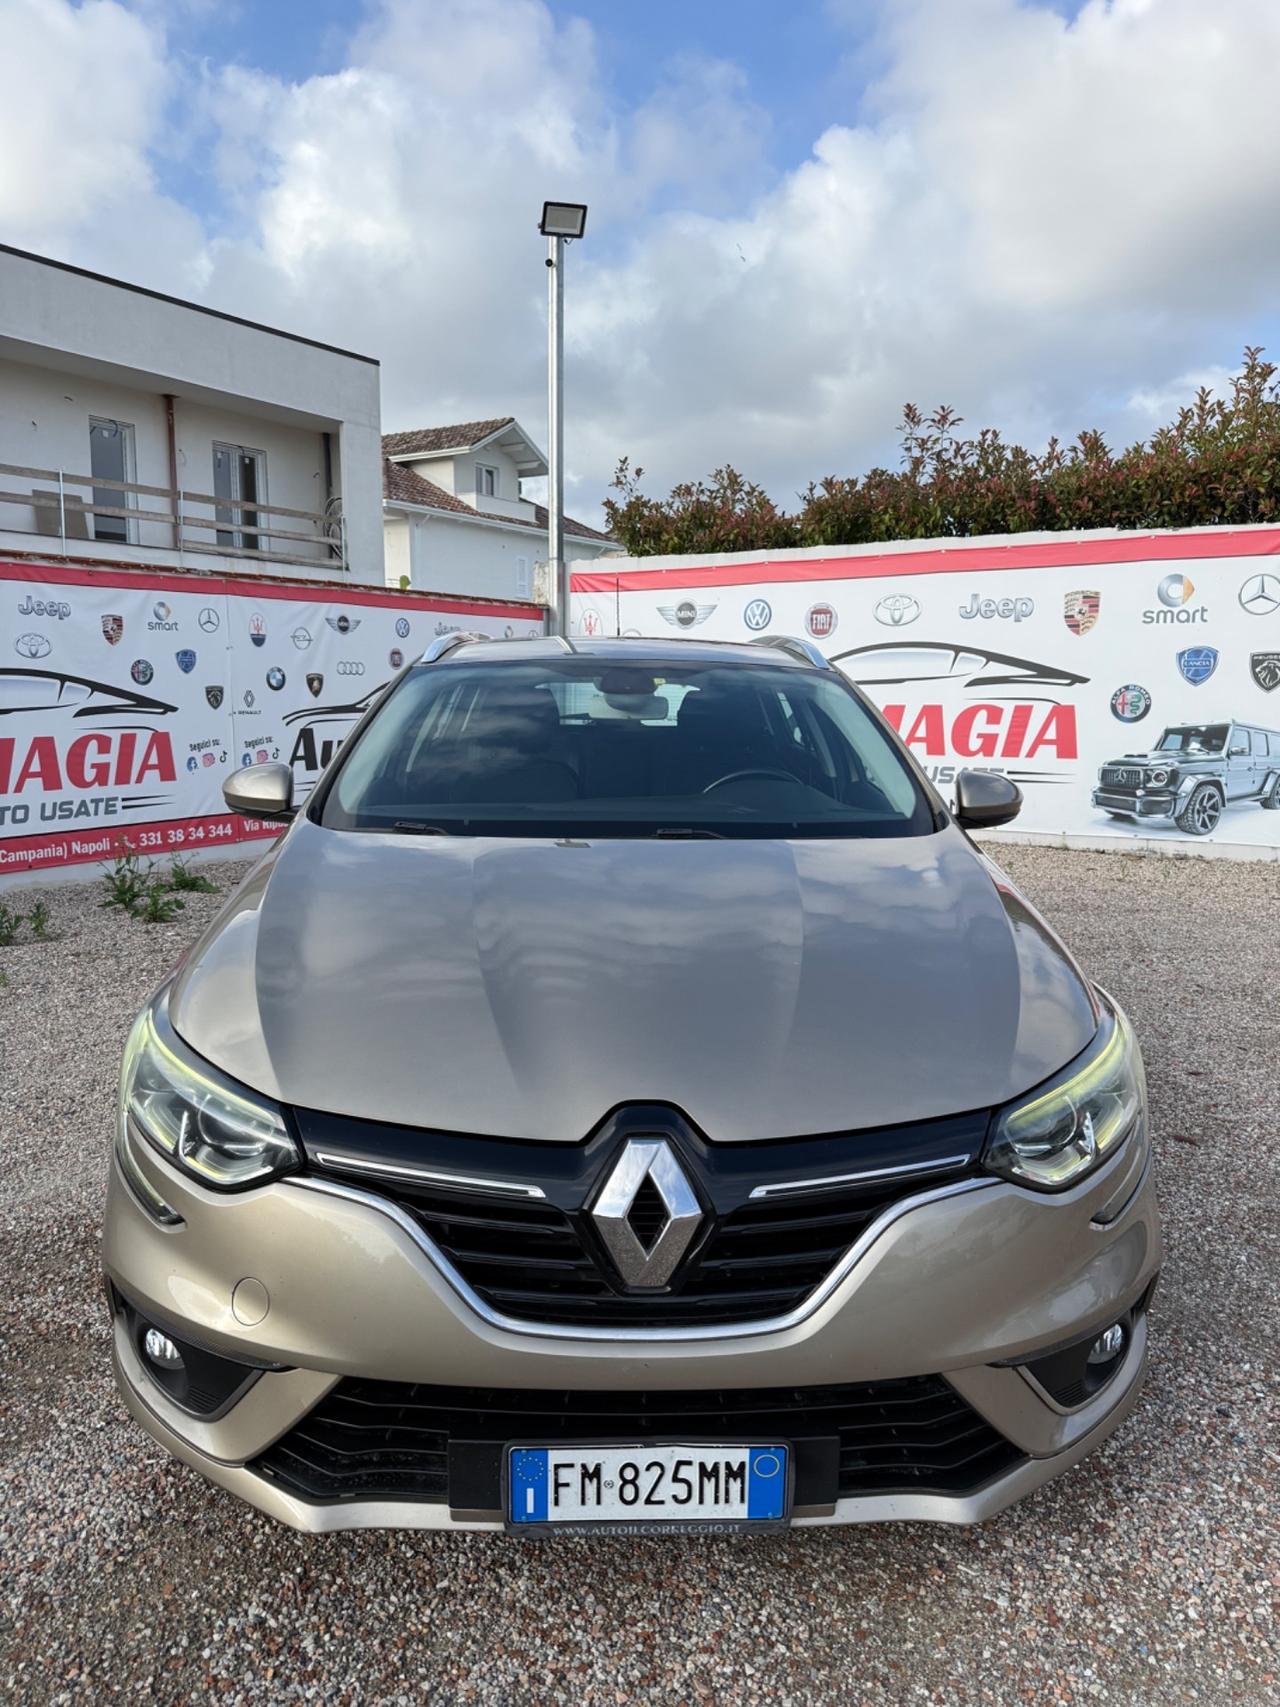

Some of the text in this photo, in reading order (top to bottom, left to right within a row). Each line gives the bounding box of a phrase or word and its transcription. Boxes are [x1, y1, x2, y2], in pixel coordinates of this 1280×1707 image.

[18, 596, 71, 620] Jeep
[958, 593, 1034, 623] Jeep
[1142, 606, 1208, 624] smart
[148, 621, 179, 632] smart
[812, 614, 831, 630] FIAT
[40, 796, 119, 821] USATE
[71, 838, 110, 855] Napoli
[140, 831, 162, 846] 331
[168, 829, 184, 843] 38
[188, 826, 205, 840] 34
[208, 823, 232, 838] 344
[244, 819, 260, 832] Via
